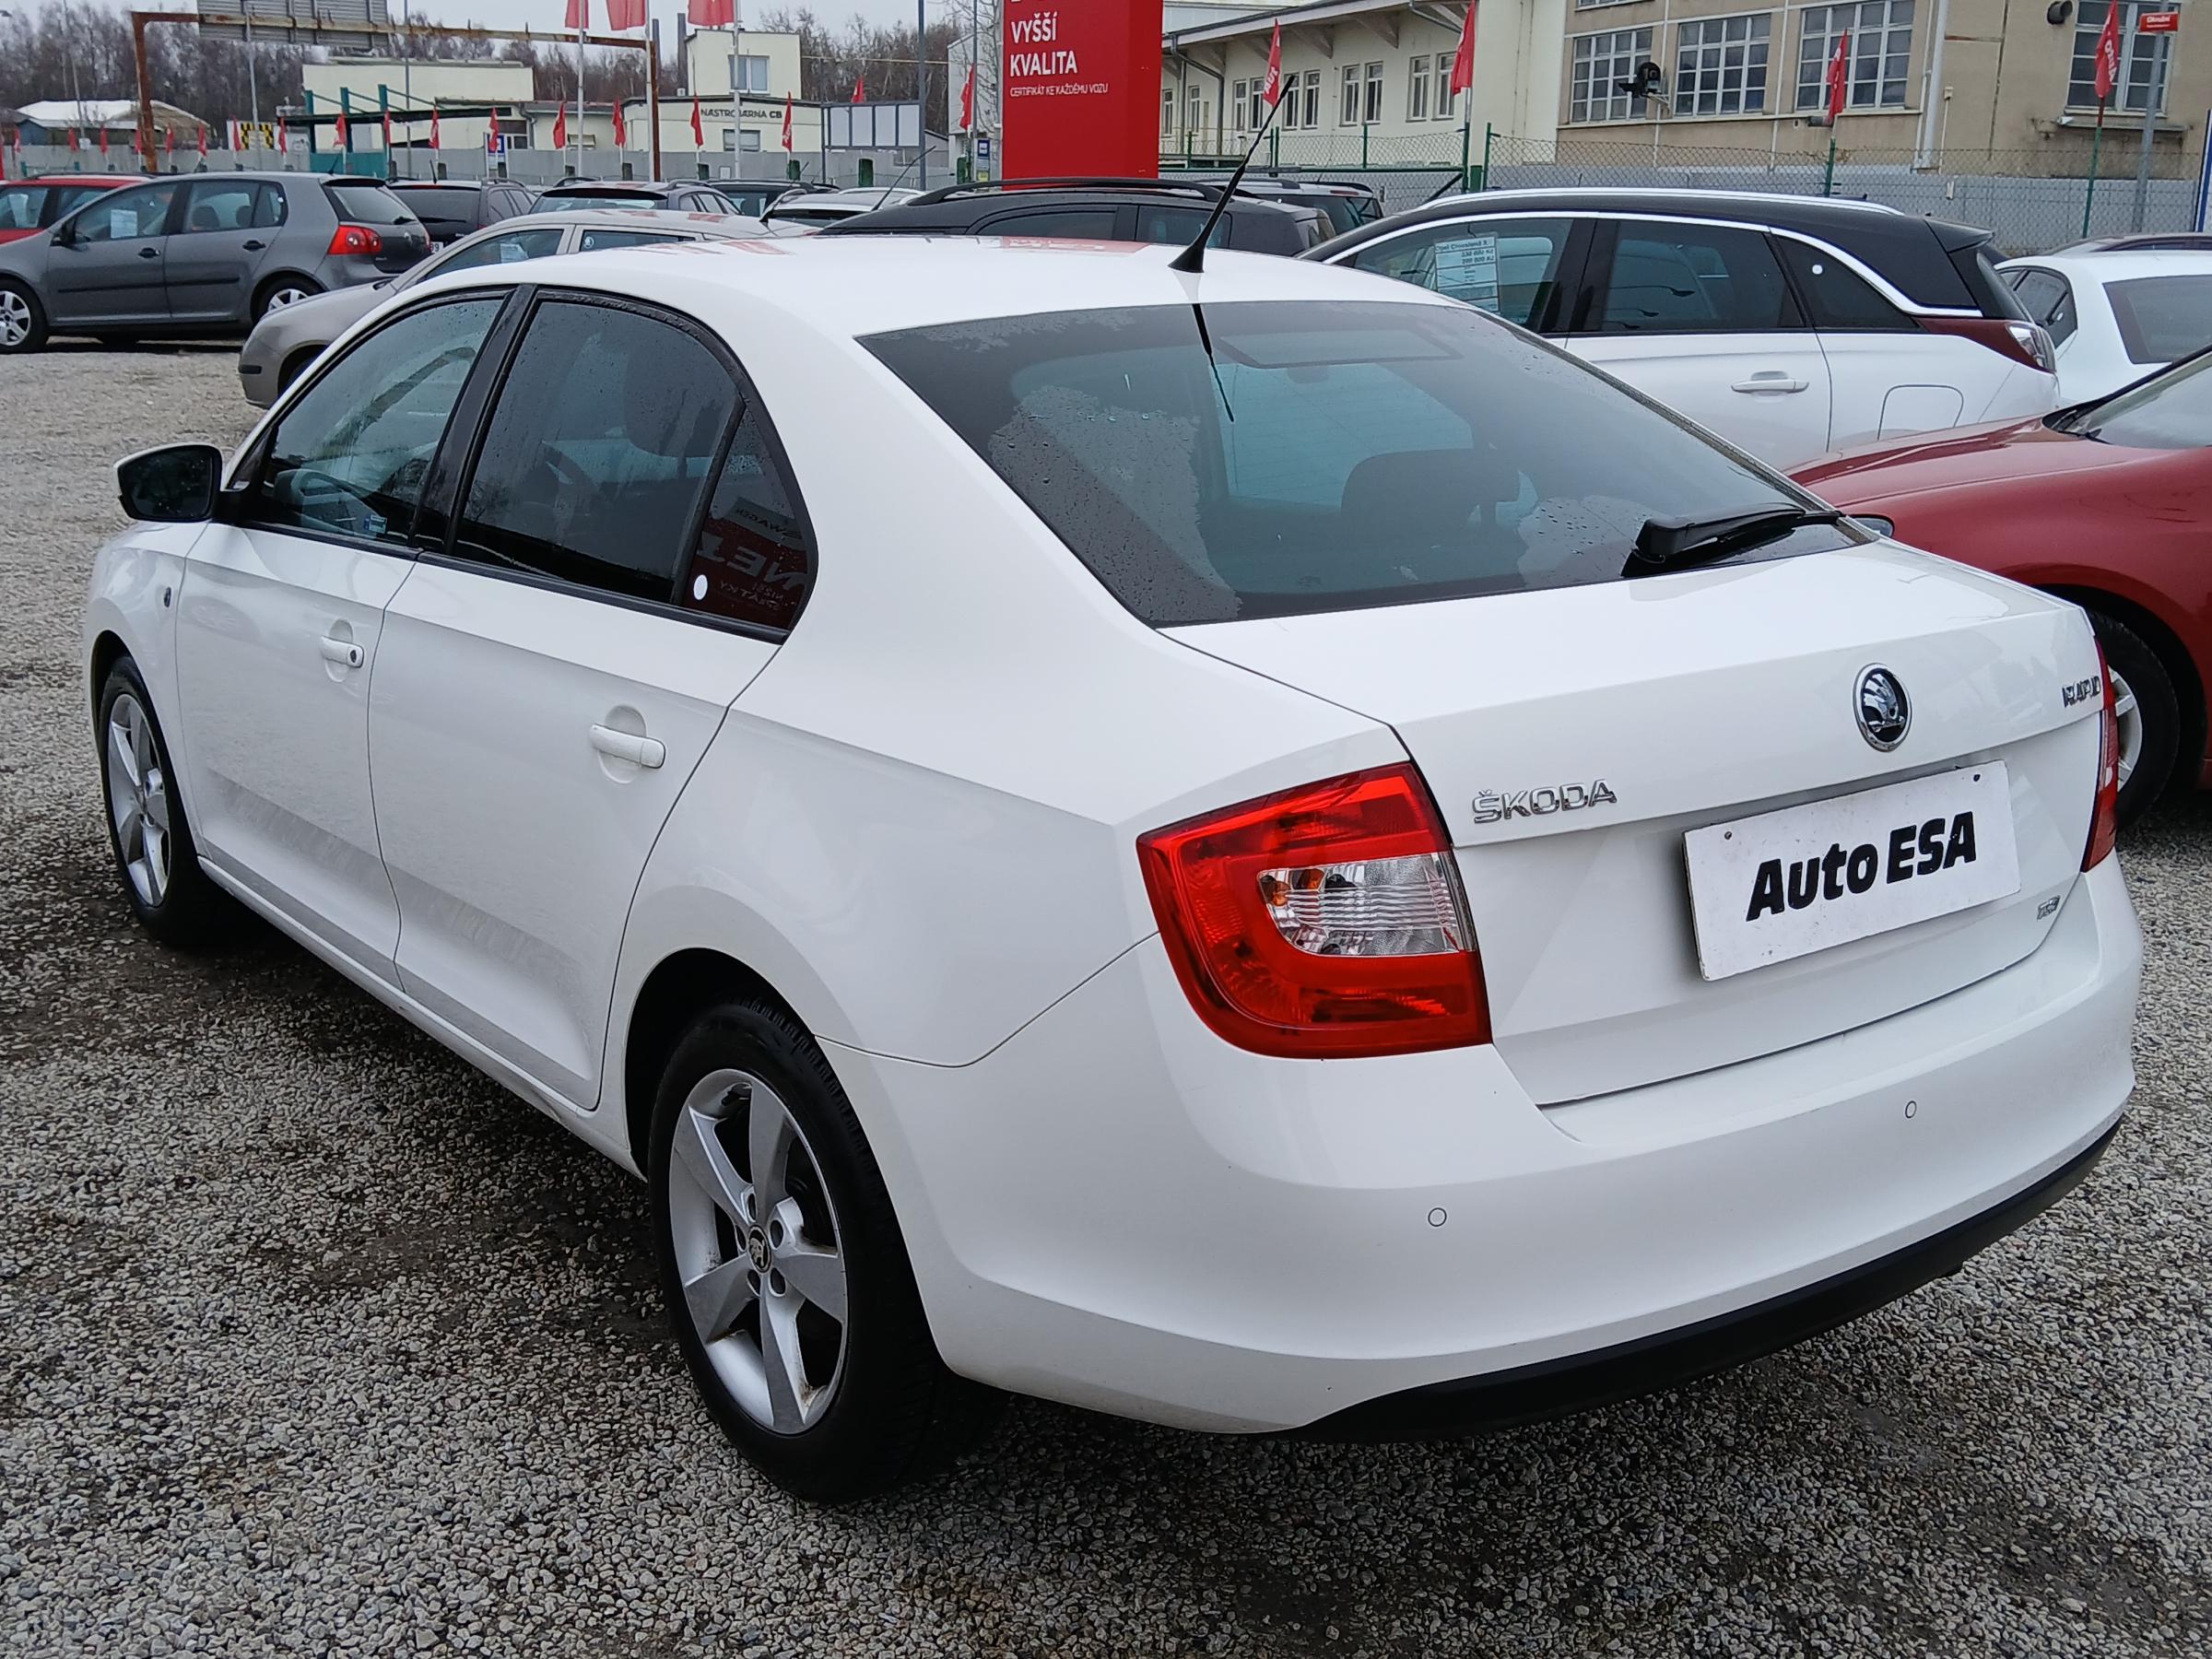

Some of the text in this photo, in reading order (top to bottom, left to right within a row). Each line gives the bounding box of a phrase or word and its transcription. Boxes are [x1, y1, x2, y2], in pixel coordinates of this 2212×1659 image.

[1010, 11, 1058, 44] VYŠŠÍ
[1009, 50, 1078, 77] KVALITA
[1088, 82, 1109, 93] VOZU
[769, 111, 782, 119] CB
[2062, 675, 2101, 708] RAPID
[1472, 778, 1618, 824] ŠKODA
[1745, 810, 1977, 923] Auto ESA
